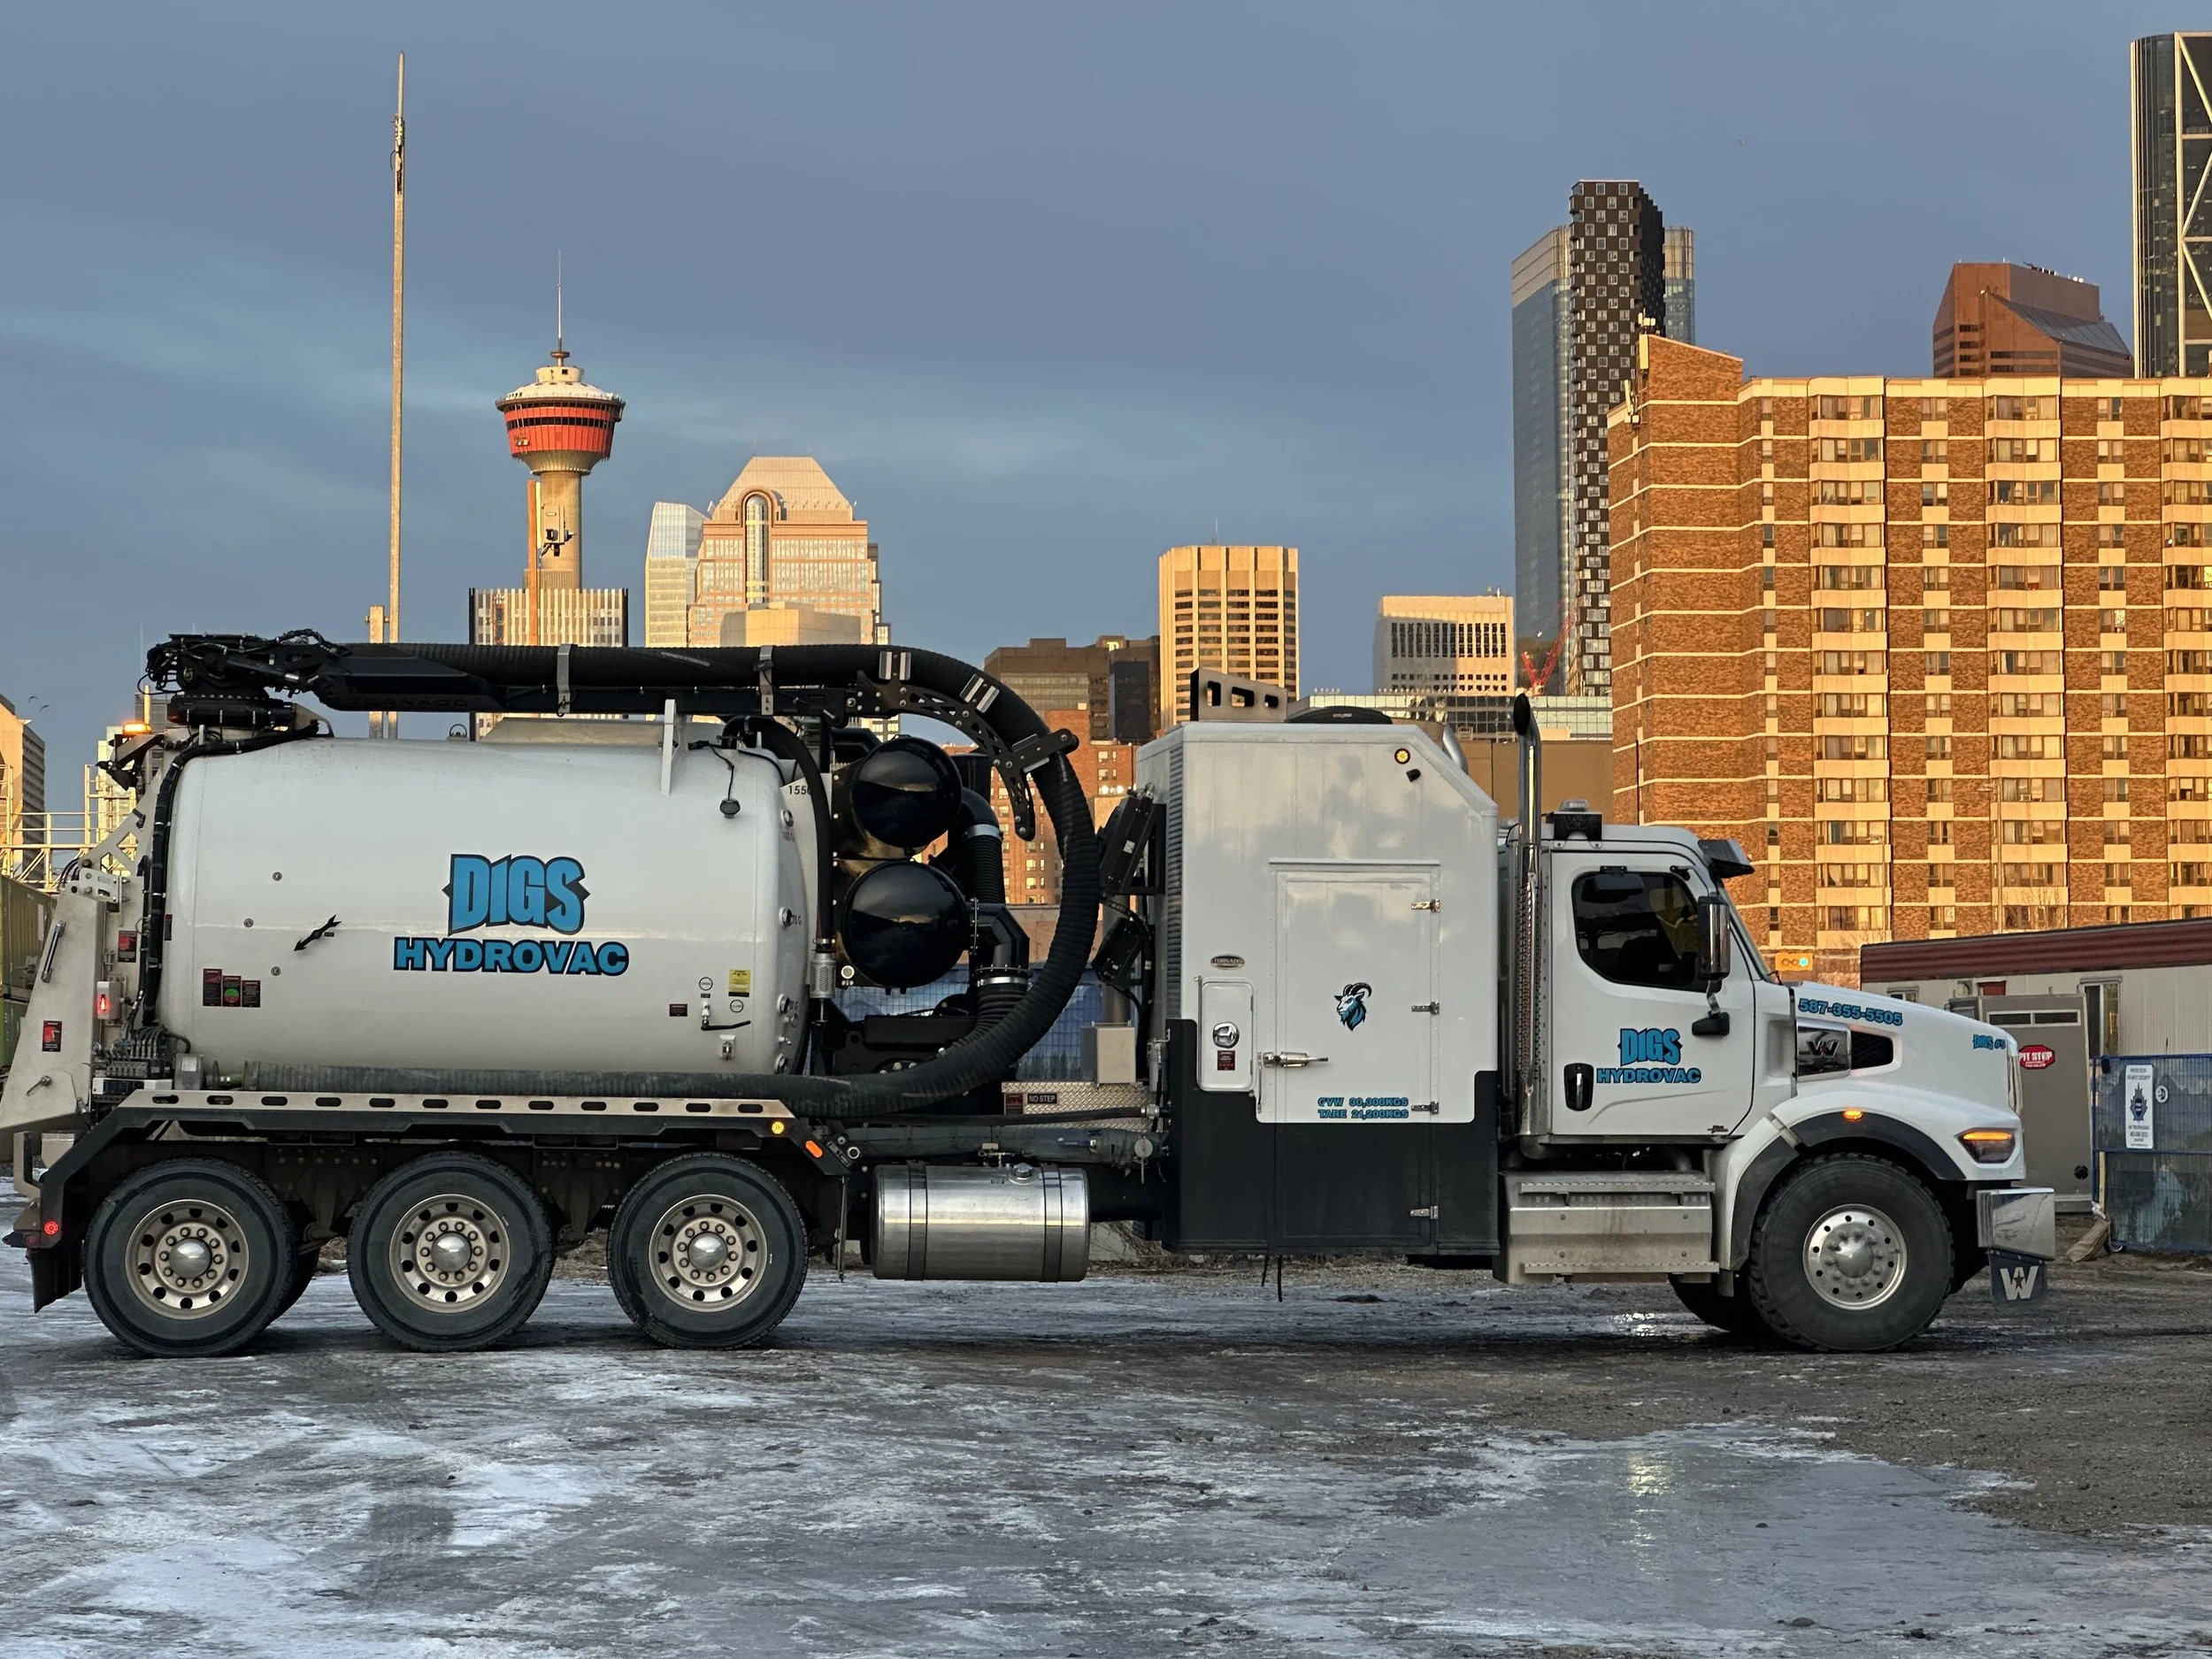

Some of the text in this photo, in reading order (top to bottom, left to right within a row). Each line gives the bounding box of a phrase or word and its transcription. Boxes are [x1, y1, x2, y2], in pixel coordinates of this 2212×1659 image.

[443, 854, 589, 936] DIGS
[394, 936, 630, 976] HYDROVAC
[1798, 997, 1903, 1026] 587-355-5505
[1618, 1028, 1683, 1067] DIGS
[2018, 1050, 2054, 1062] PIT STOP
[1596, 1067, 1701, 1084] HYDROVAC
[1317, 1109, 1348, 1119] TARE
[2000, 1265, 2039, 1302] W
